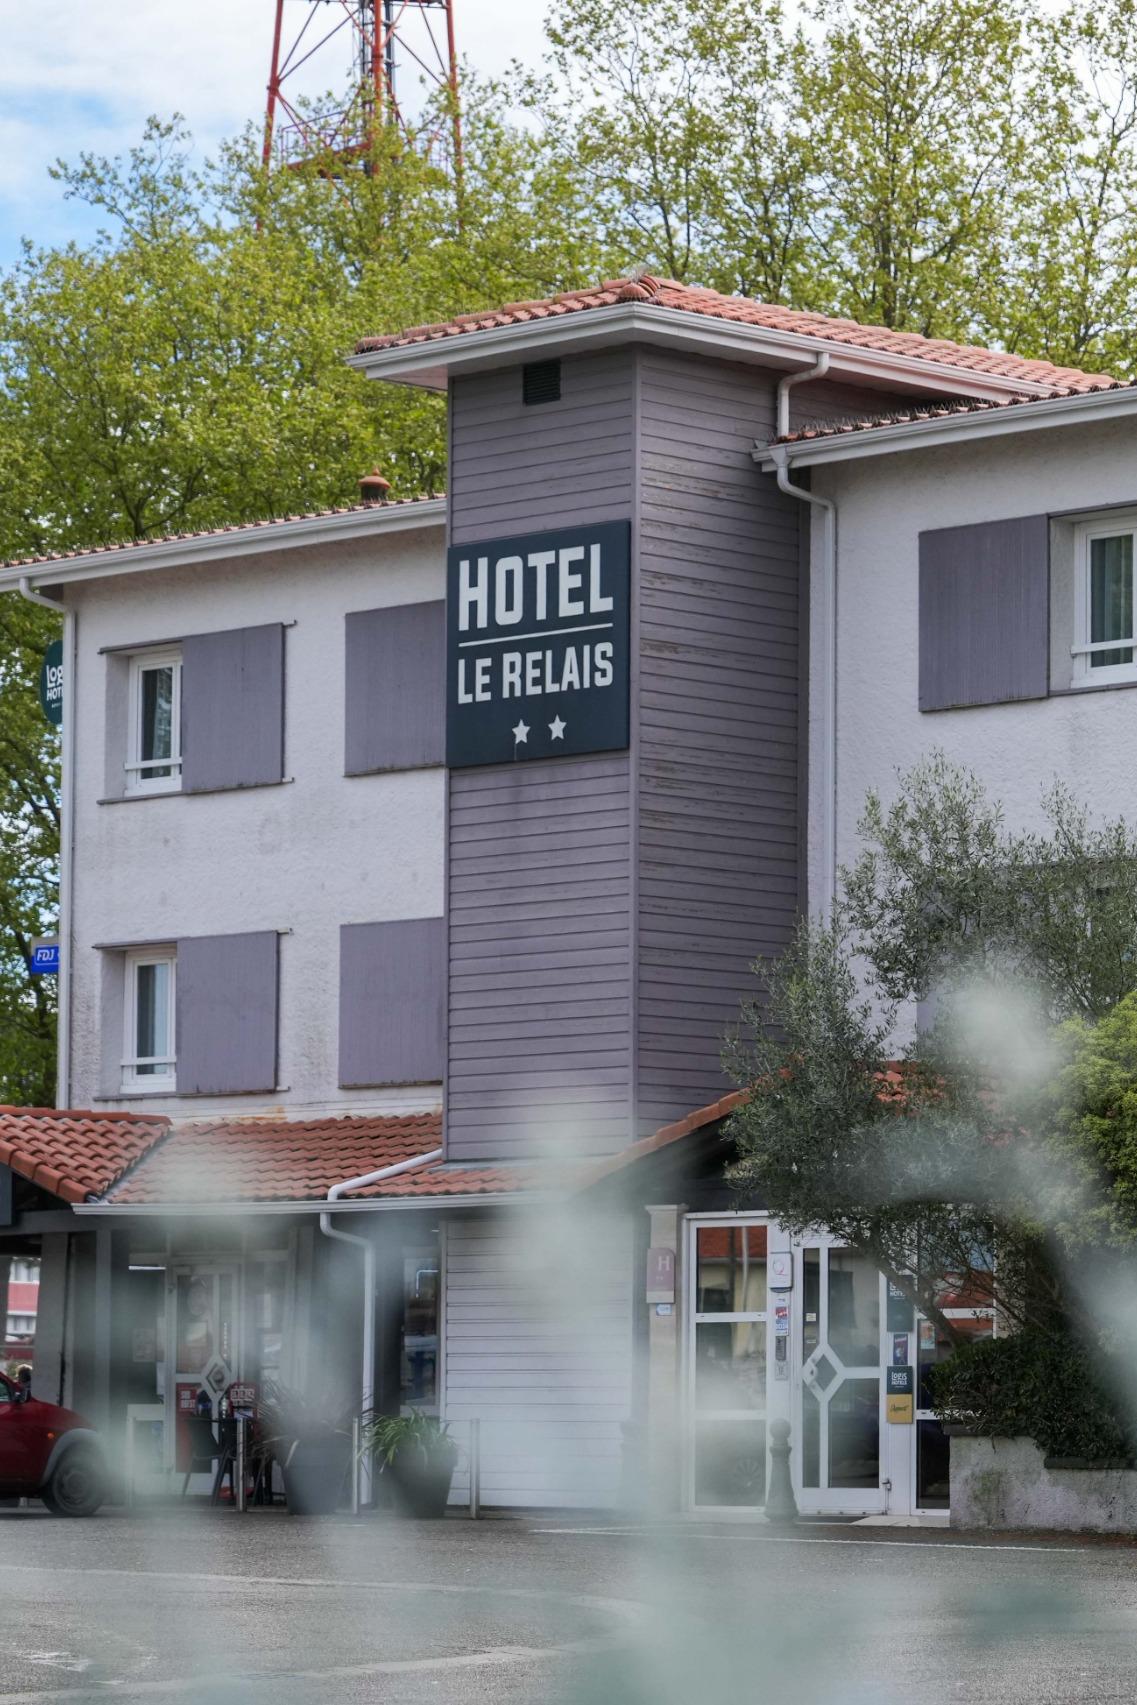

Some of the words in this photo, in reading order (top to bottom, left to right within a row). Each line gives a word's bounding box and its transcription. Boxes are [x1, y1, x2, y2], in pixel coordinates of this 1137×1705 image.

[458, 543, 614, 632] HOTEL
[457, 657, 492, 705] LE
[502, 641, 613, 699] RELAIS
[37, 949, 55, 961] FDJ
[658, 1255, 670, 1271] H
